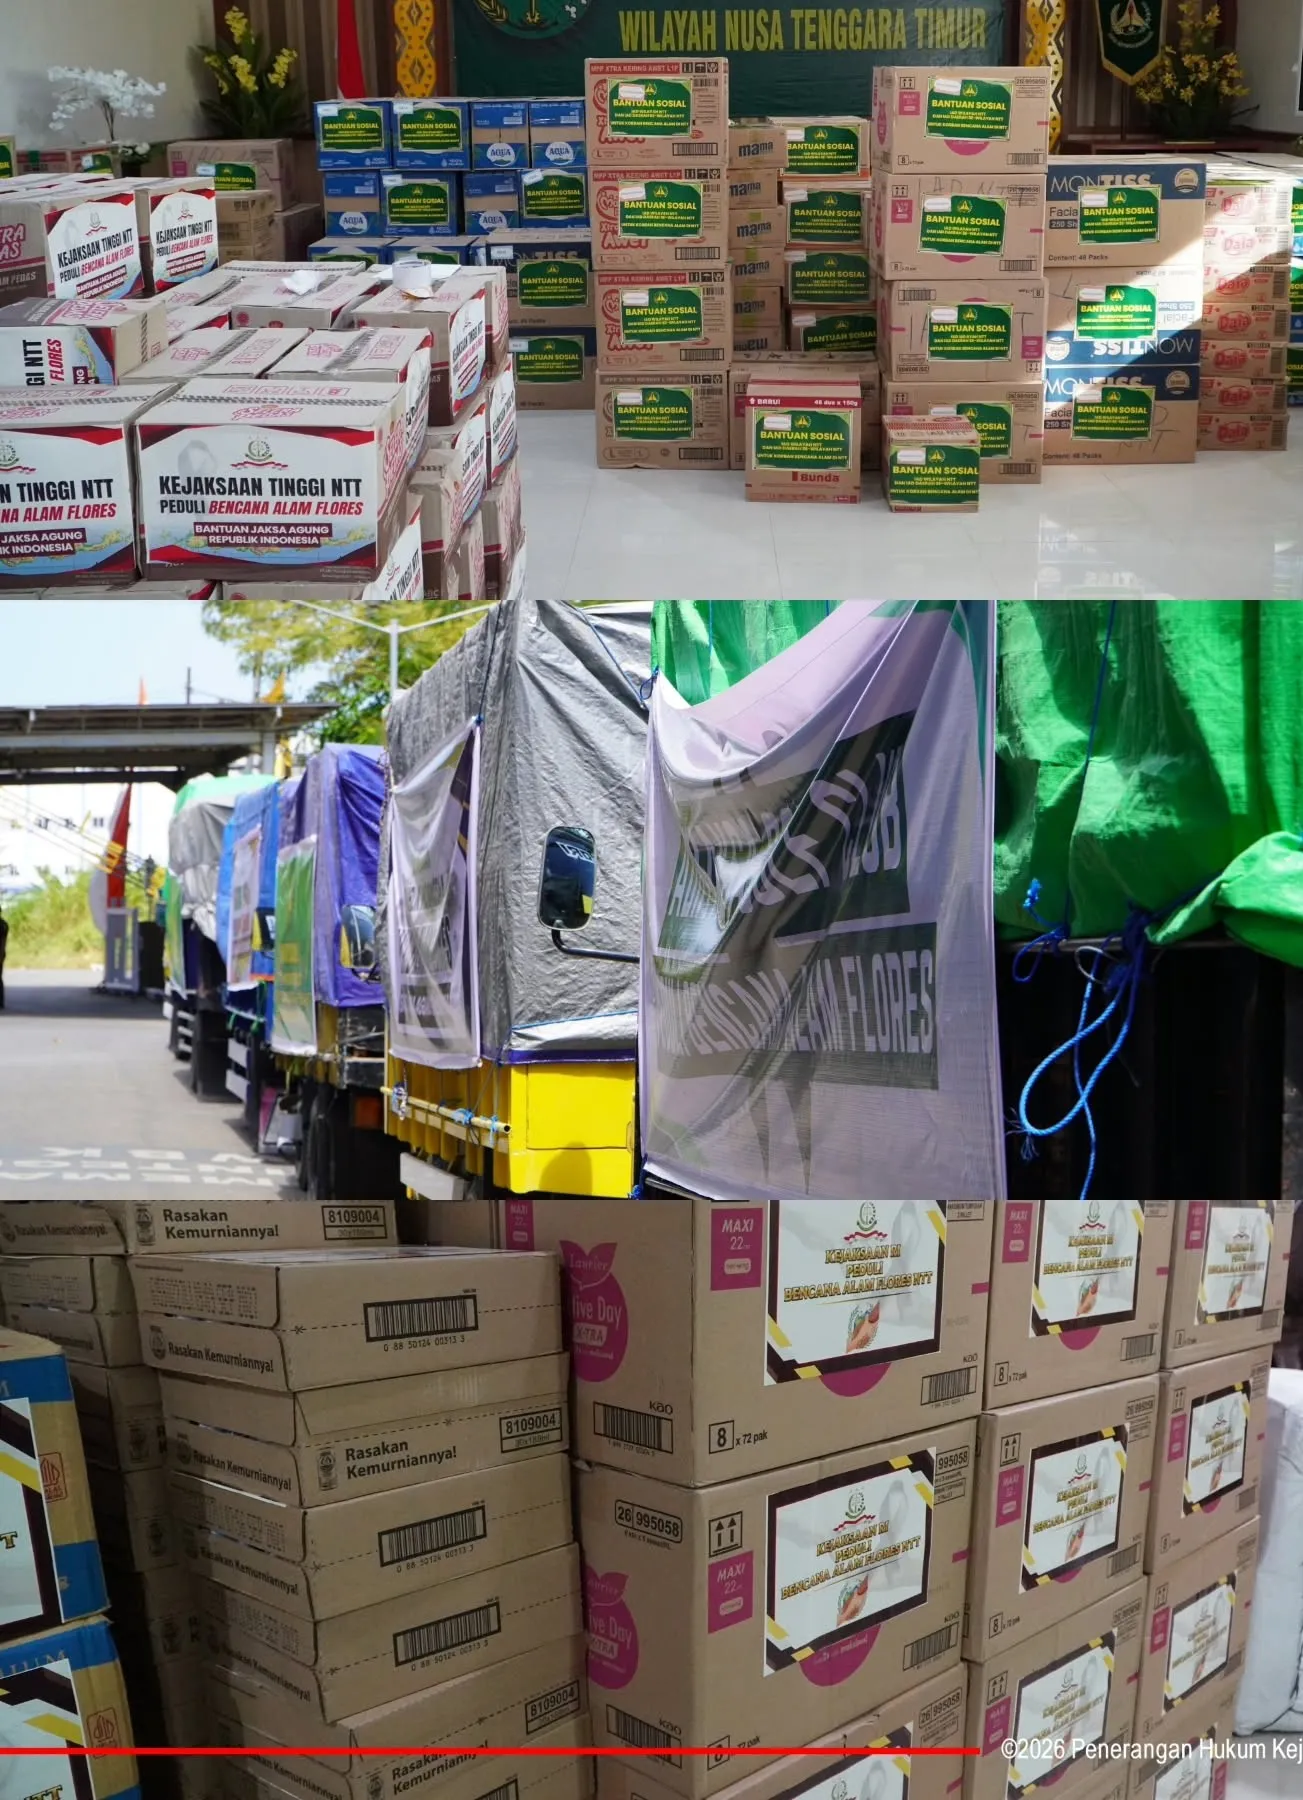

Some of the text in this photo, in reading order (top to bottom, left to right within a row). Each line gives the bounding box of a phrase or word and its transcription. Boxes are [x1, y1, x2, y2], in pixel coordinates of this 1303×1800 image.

[618, 8, 986, 51] WILAYAH NUSA TENGGARA TIMUR
[613, 99, 686, 108] BANTUAN SOSIAL
[932, 100, 1006, 111] BANTUAN SOSIAL
[490, 149, 511, 158] AQUA
[549, 148, 569, 156] AQUA
[738, 141, 773, 157] mama
[667, 202, 696, 210] SOSIAL
[1084, 207, 1154, 216] BANTUAN SOSIAL
[343, 216, 364, 225] AQUA
[482, 216, 503, 225] AQUA
[737, 221, 771, 237] mama
[926, 215, 1000, 226] BANTUAN SOSIAL
[156, 226, 186, 244] KEJAKSAAN
[204, 220, 212, 232] NTT
[57, 228, 132, 268] KEJAKSAAN TINGGI NTT
[60, 245, 134, 283] PEDULI BENCANA ALAM FLORES
[735, 260, 770, 276] mama
[625, 306, 697, 316] BANTUAN SOSIAL
[976, 325, 1006, 333] SOSIAL
[22, 339, 44, 367] NTT
[47, 338, 64, 382] FLORES
[659, 406, 688, 414] SOSIAL
[760, 431, 844, 441] BANTUAN SOSIAL
[800, 473, 840, 482] Bunda
[893, 466, 979, 474] BANTUAN SOSIAL
[16, 480, 76, 502] TINGGI
[82, 478, 113, 499] NTT
[159, 476, 362, 497] KEJAKSAAN TINGGI NTT
[23, 506, 63, 523] ALAM
[67, 503, 117, 520] FLORES
[160, 500, 364, 516] PEDULI BENCANA ALAM FLORES
[1, 530, 83, 544] JAKSA AGUNG
[195, 525, 329, 534] BANTUAN JAKSA AGUNG
[13, 542, 73, 554] INDONESIA
[208, 536, 319, 545] REPUBLIK INDONESIA
[839, 949, 933, 1054] FLORES
[163, 1209, 228, 1222] Rasakan
[328, 1211, 380, 1223] 8109004
[165, 1224, 279, 1240] Kemurniannya!
[722, 1218, 754, 1232] MAXI
[825, 1244, 901, 1264] KEJAKSAAN RI
[846, 1261, 883, 1278] PEDULI
[784, 1271, 932, 1302] BENCANA ALAM FLORES NTT
[598, 1296, 622, 1330] Day
[383, 1344, 388, 1352] 0
[393, 1342, 404, 1350] 88
[460, 1335, 465, 1343] 3
[168, 1342, 274, 1372] Rasakan Kemurniannya!
[650, 1400, 673, 1415] kao
[505, 1413, 557, 1435] 8109004
[717, 1428, 768, 1447] 8 x 72 pak
[346, 1440, 408, 1461] Rasakan
[347, 1445, 457, 1480] Kemurniannya!
[938, 1450, 968, 1470] 995058
[193, 1450, 291, 1491] Rasakan Kemurniannya!
[618, 1506, 679, 1538] 26 995058
[816, 1520, 889, 1556] KEJAKSAAN RI
[835, 1542, 872, 1563] PEDULI
[717, 1562, 745, 1582] MAXI
[781, 1535, 921, 1600] BENCANA ALAM FLORES NTT
[609, 1616, 631, 1650] Day
[529, 1687, 575, 1718] 8109004
[933, 1692, 960, 1716] 995058
